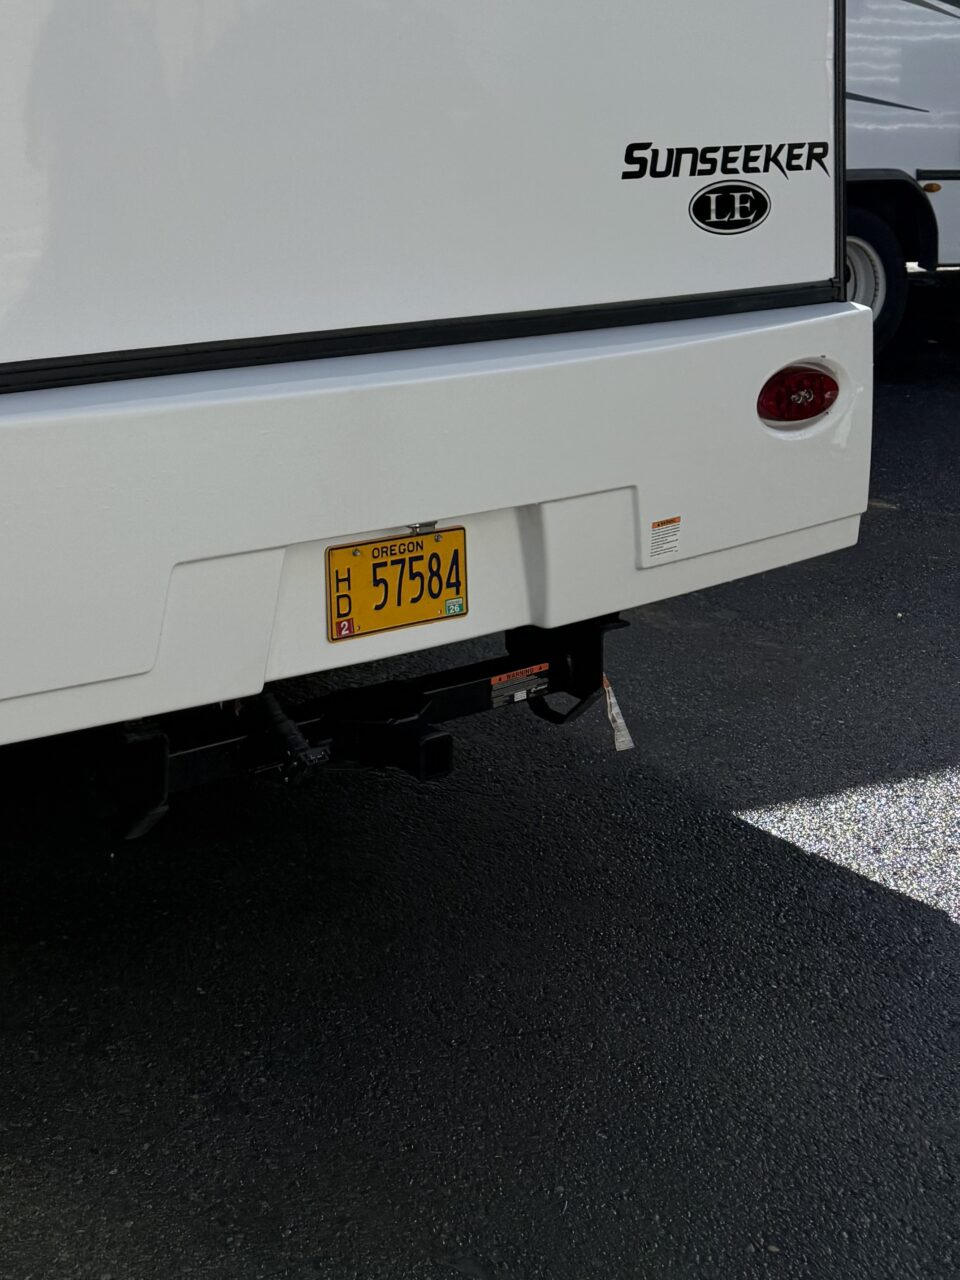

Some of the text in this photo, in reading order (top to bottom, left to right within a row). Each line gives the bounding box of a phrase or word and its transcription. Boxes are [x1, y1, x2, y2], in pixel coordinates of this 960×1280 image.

[705, 191, 757, 223] LE
[372, 541, 424, 559] OREGON
[372, 549, 461, 611] 57584
[340, 621, 349, 636] 2
